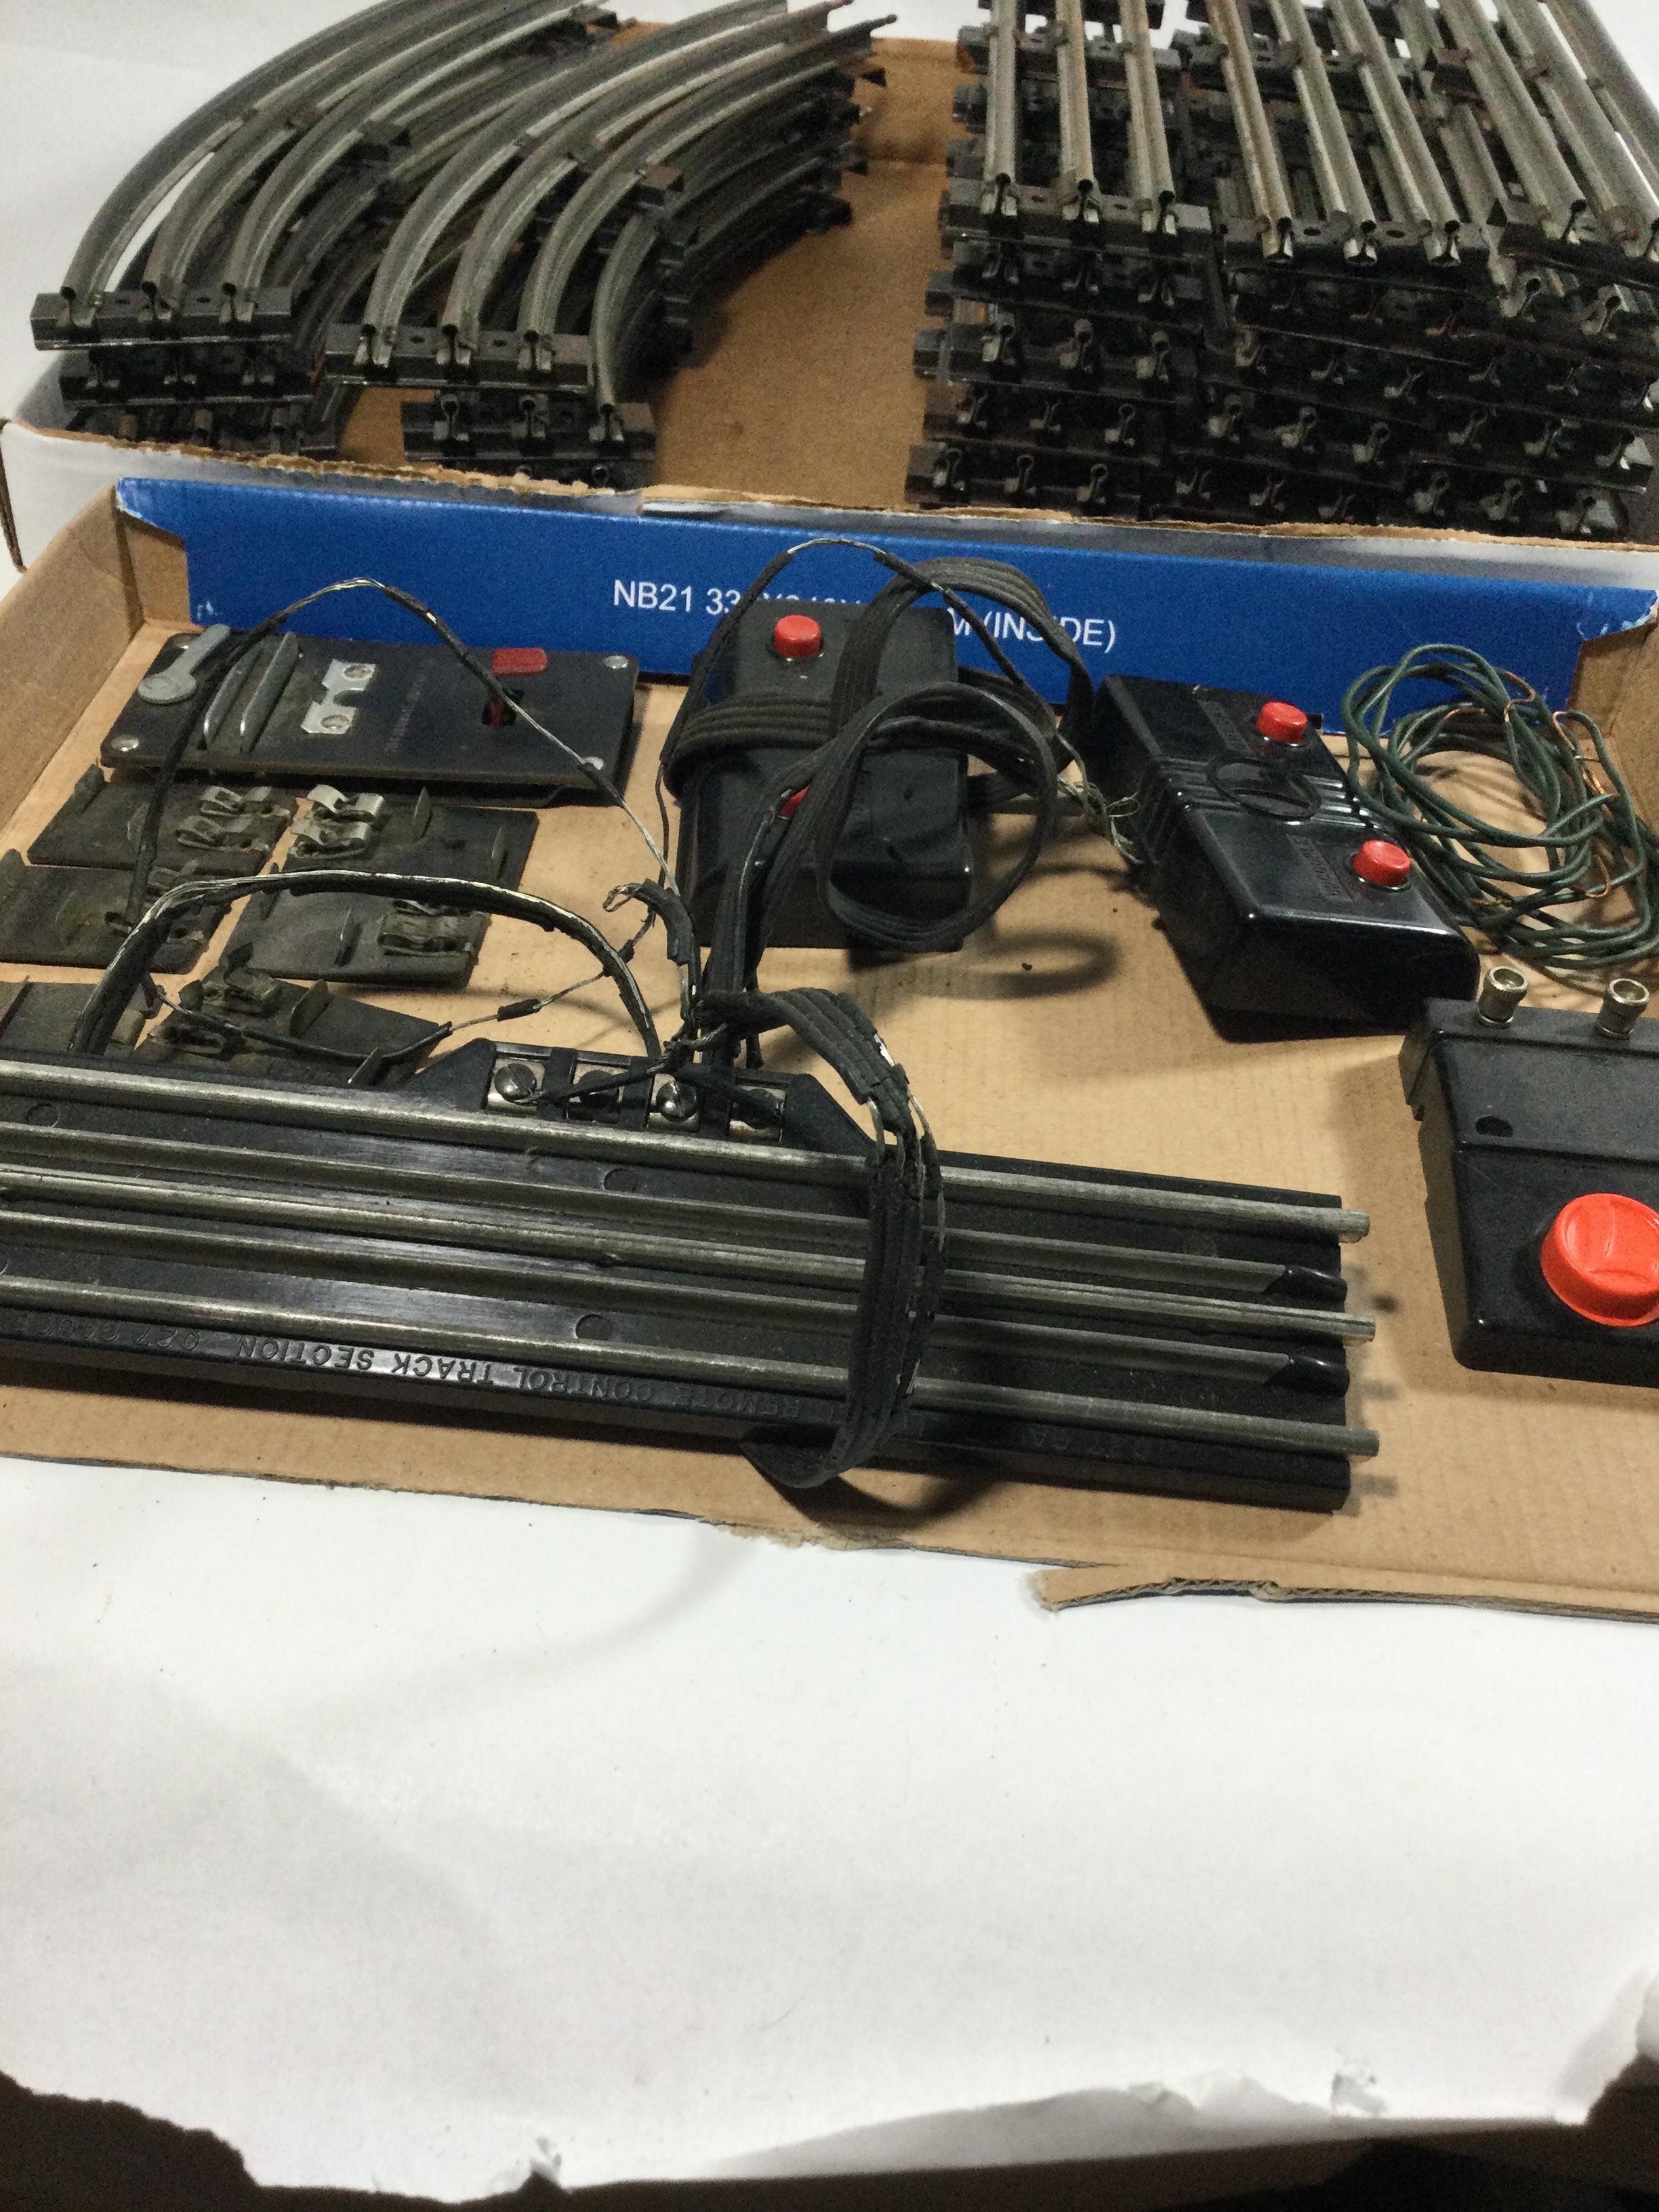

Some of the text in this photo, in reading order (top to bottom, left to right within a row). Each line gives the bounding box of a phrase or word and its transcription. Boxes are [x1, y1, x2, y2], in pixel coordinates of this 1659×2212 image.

[614, 579, 692, 612] NB21
[983, 611, 1116, 653] (INDE)
[237, 1334, 375, 1372] SECTION
[390, 1353, 494, 1386] TRACK
[512, 1368, 653, 1403] CONTROL
